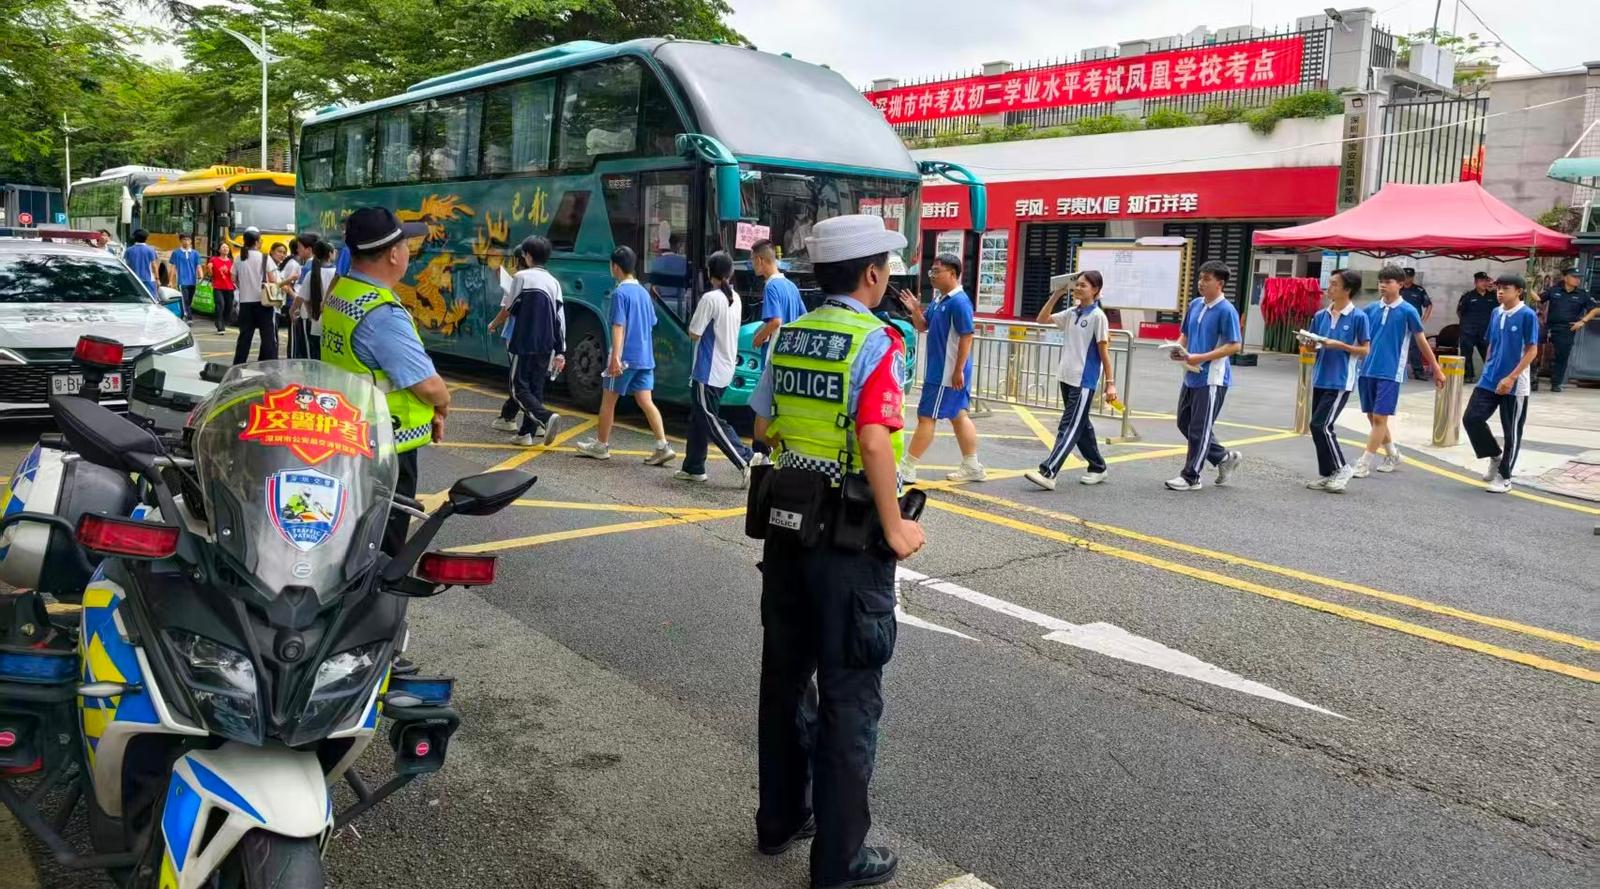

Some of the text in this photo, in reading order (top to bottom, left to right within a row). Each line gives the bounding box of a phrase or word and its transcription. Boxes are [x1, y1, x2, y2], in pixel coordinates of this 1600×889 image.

[875, 48, 1277, 119] 深圳市中考及初二学业水平考试凤凰学校考点
[1127, 193, 1198, 214] 知行并举
[24, 315, 118, 323] POLICE
[777, 331, 847, 360] 深圳交警
[775, 369, 839, 399] POLICE
[266, 409, 358, 442] 交警护考
[293, 528, 321, 537] TRAFFIC
[771, 516, 798, 528] POLICE
[293, 533, 319, 541] PATROL
